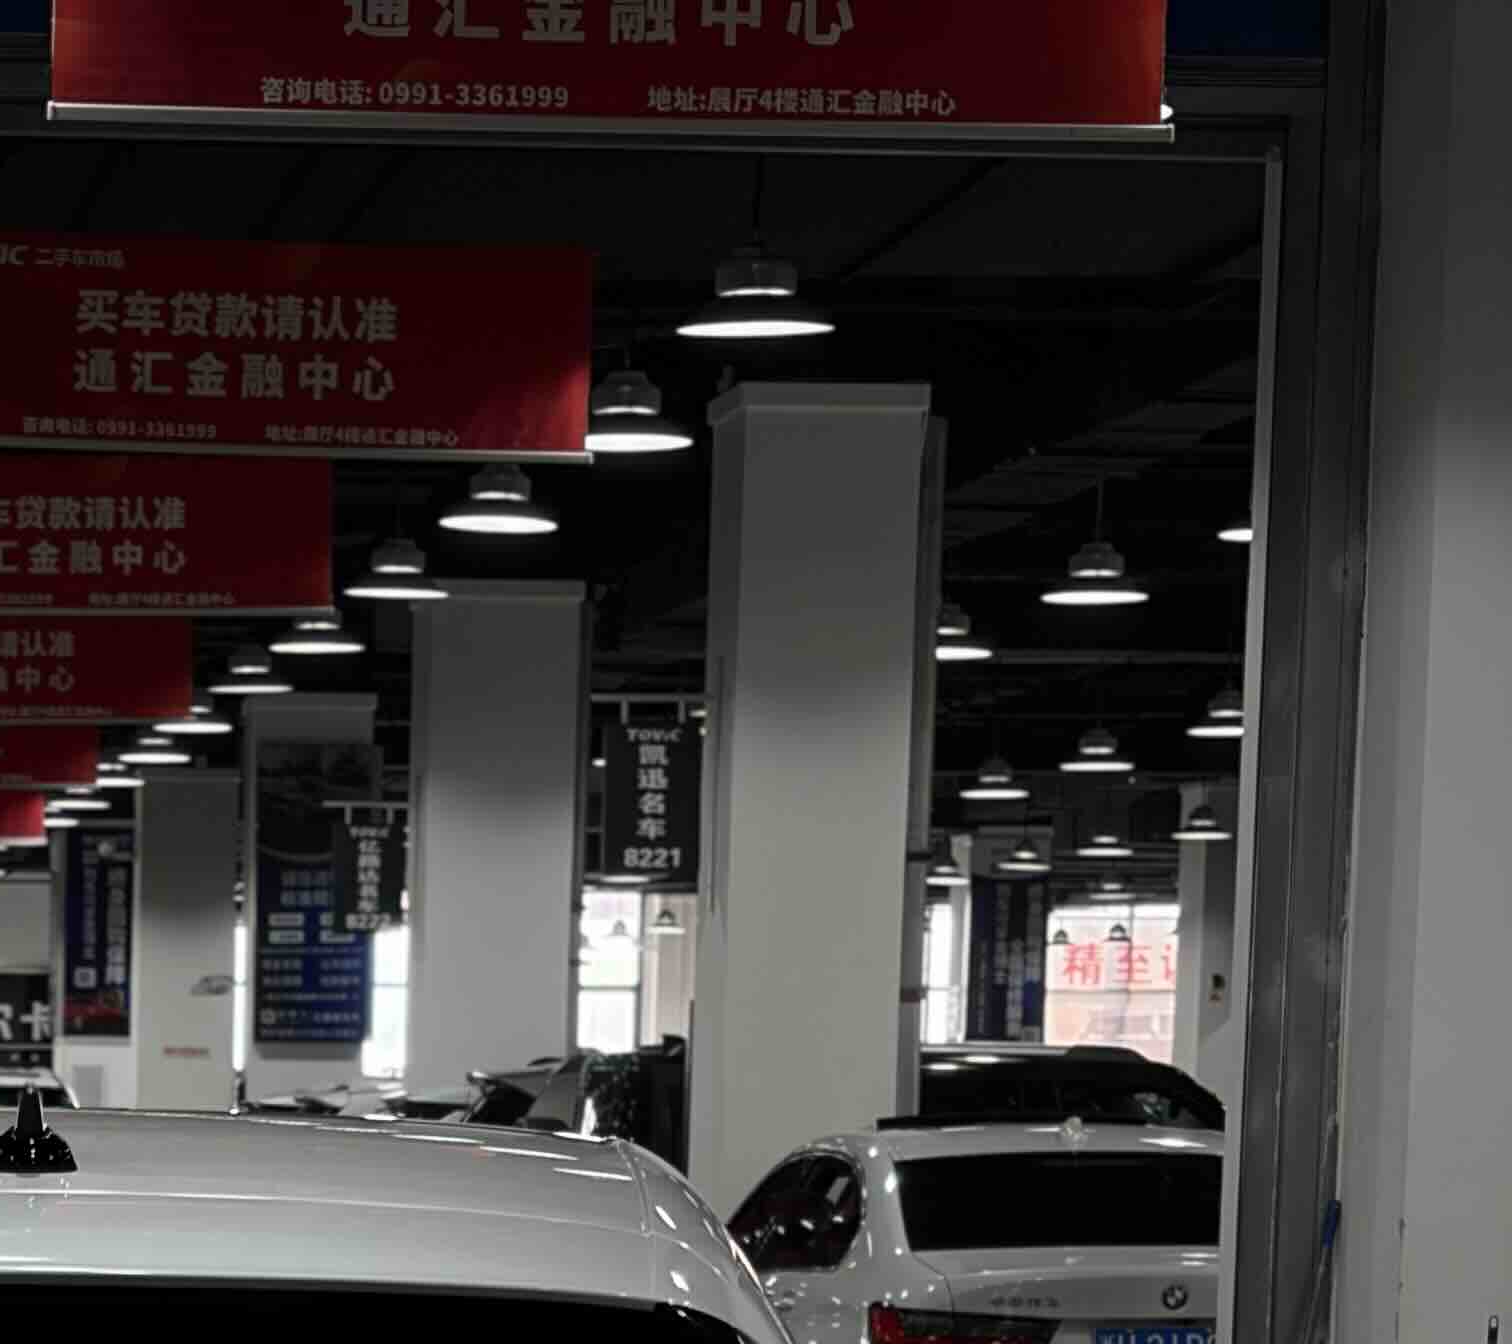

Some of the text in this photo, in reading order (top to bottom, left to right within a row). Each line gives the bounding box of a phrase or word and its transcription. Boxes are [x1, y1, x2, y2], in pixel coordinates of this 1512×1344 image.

[75, 289, 399, 343] 买车贷款请认准
[72, 348, 395, 402] 通汇金融中心
[624, 847, 681, 869] 8221
